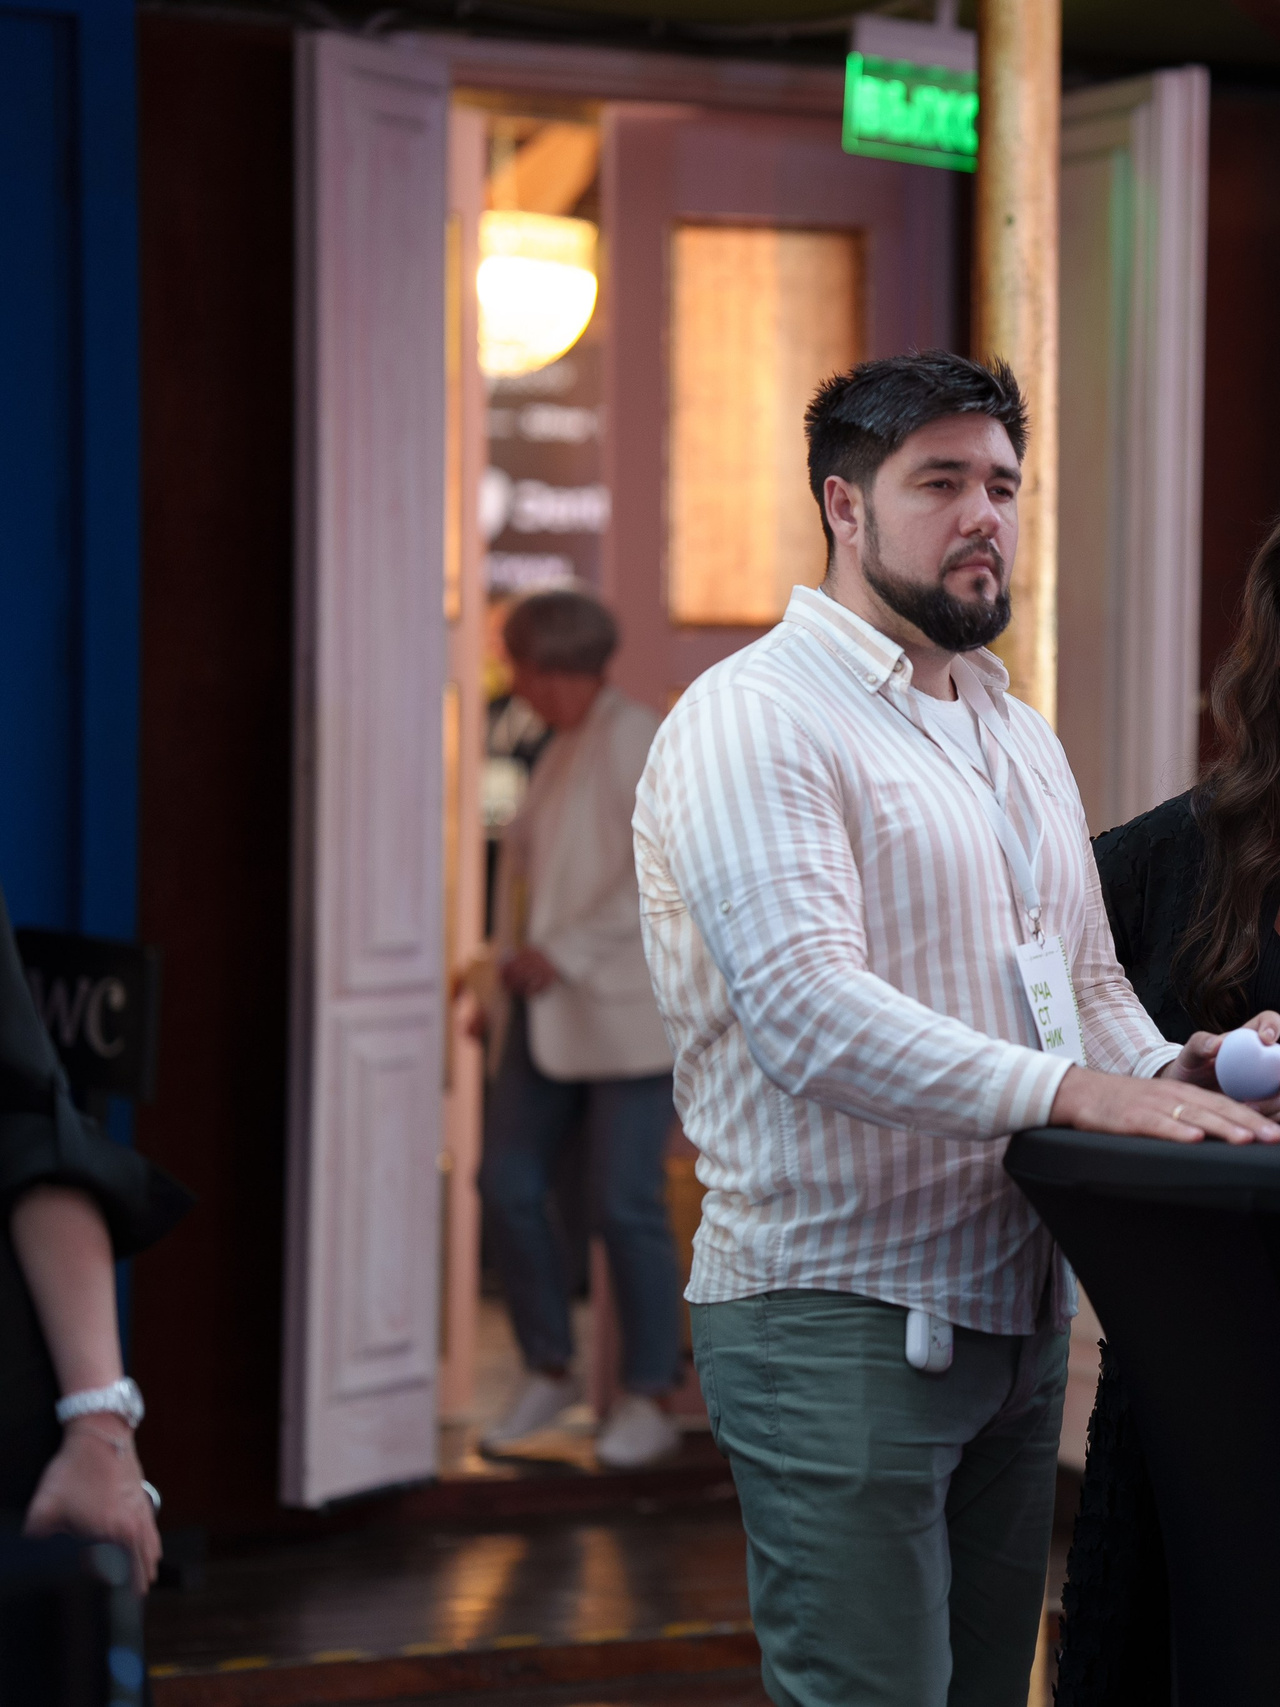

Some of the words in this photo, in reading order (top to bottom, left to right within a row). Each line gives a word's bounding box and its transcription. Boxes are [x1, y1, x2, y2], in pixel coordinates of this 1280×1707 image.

[1030, 981, 1053, 1003] УЧА
[1038, 1006, 1051, 1026] СТ
[1044, 1027, 1065, 1050] НИК
